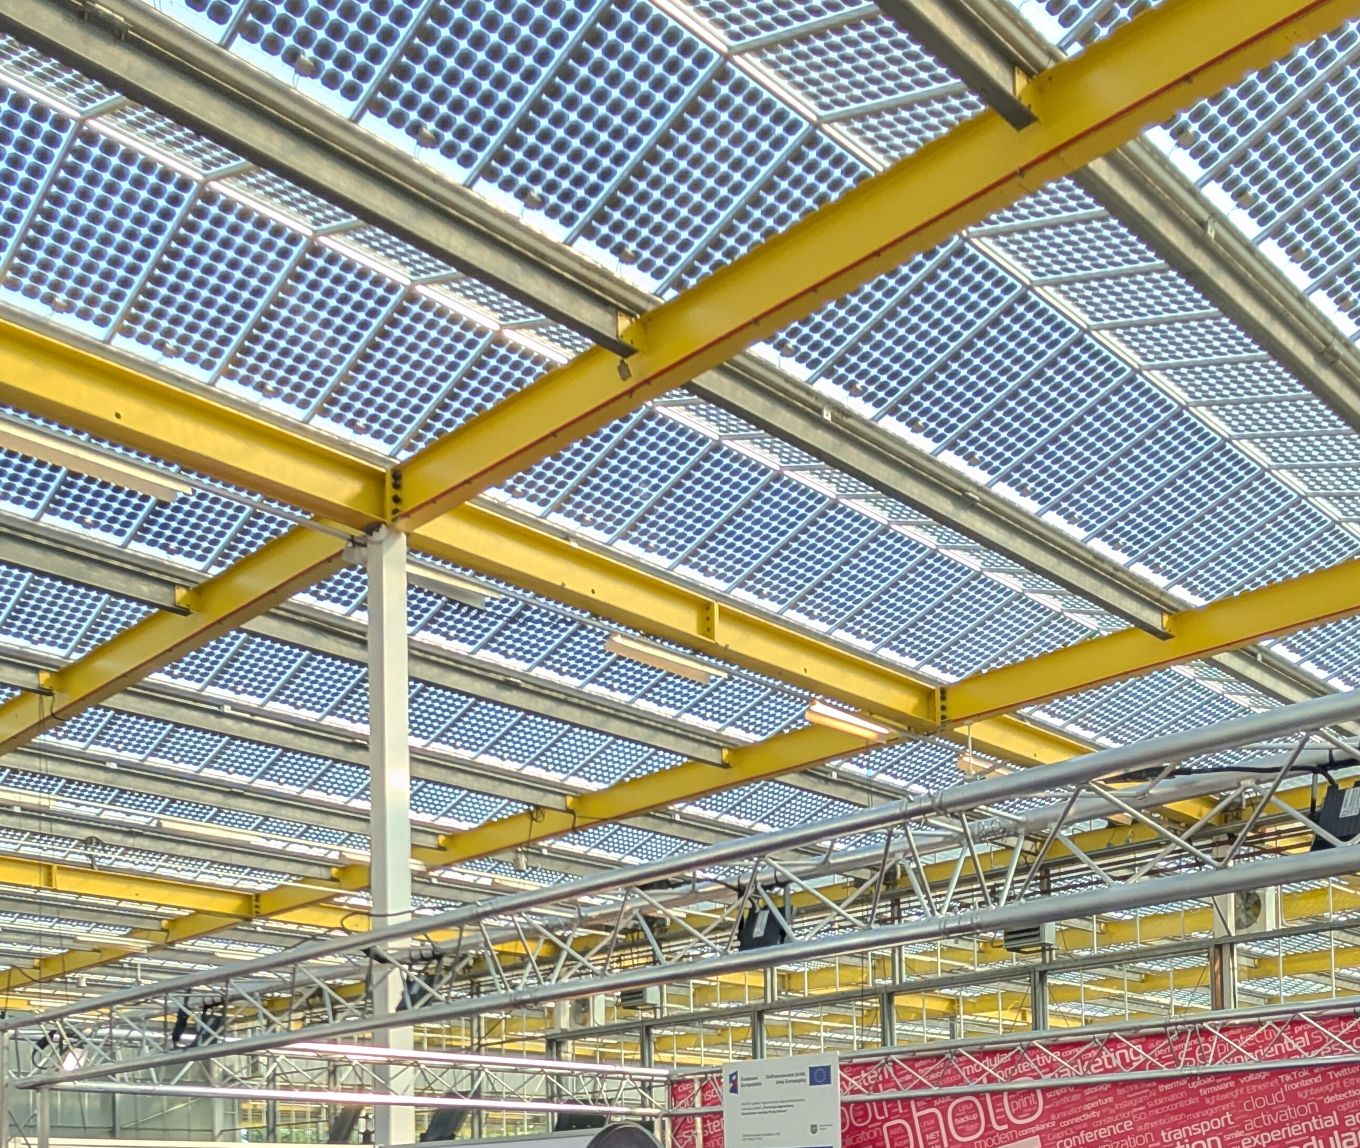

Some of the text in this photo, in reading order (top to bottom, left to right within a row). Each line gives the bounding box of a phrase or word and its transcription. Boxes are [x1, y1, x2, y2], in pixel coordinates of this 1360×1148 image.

[1284, 1075, 1322, 1092] frontend
[1243, 1087, 1285, 1112] cloud
[1161, 1111, 1234, 1143] transport
[1241, 1111, 1339, 1148] experiential
[1244, 1101, 1319, 1131] activation
